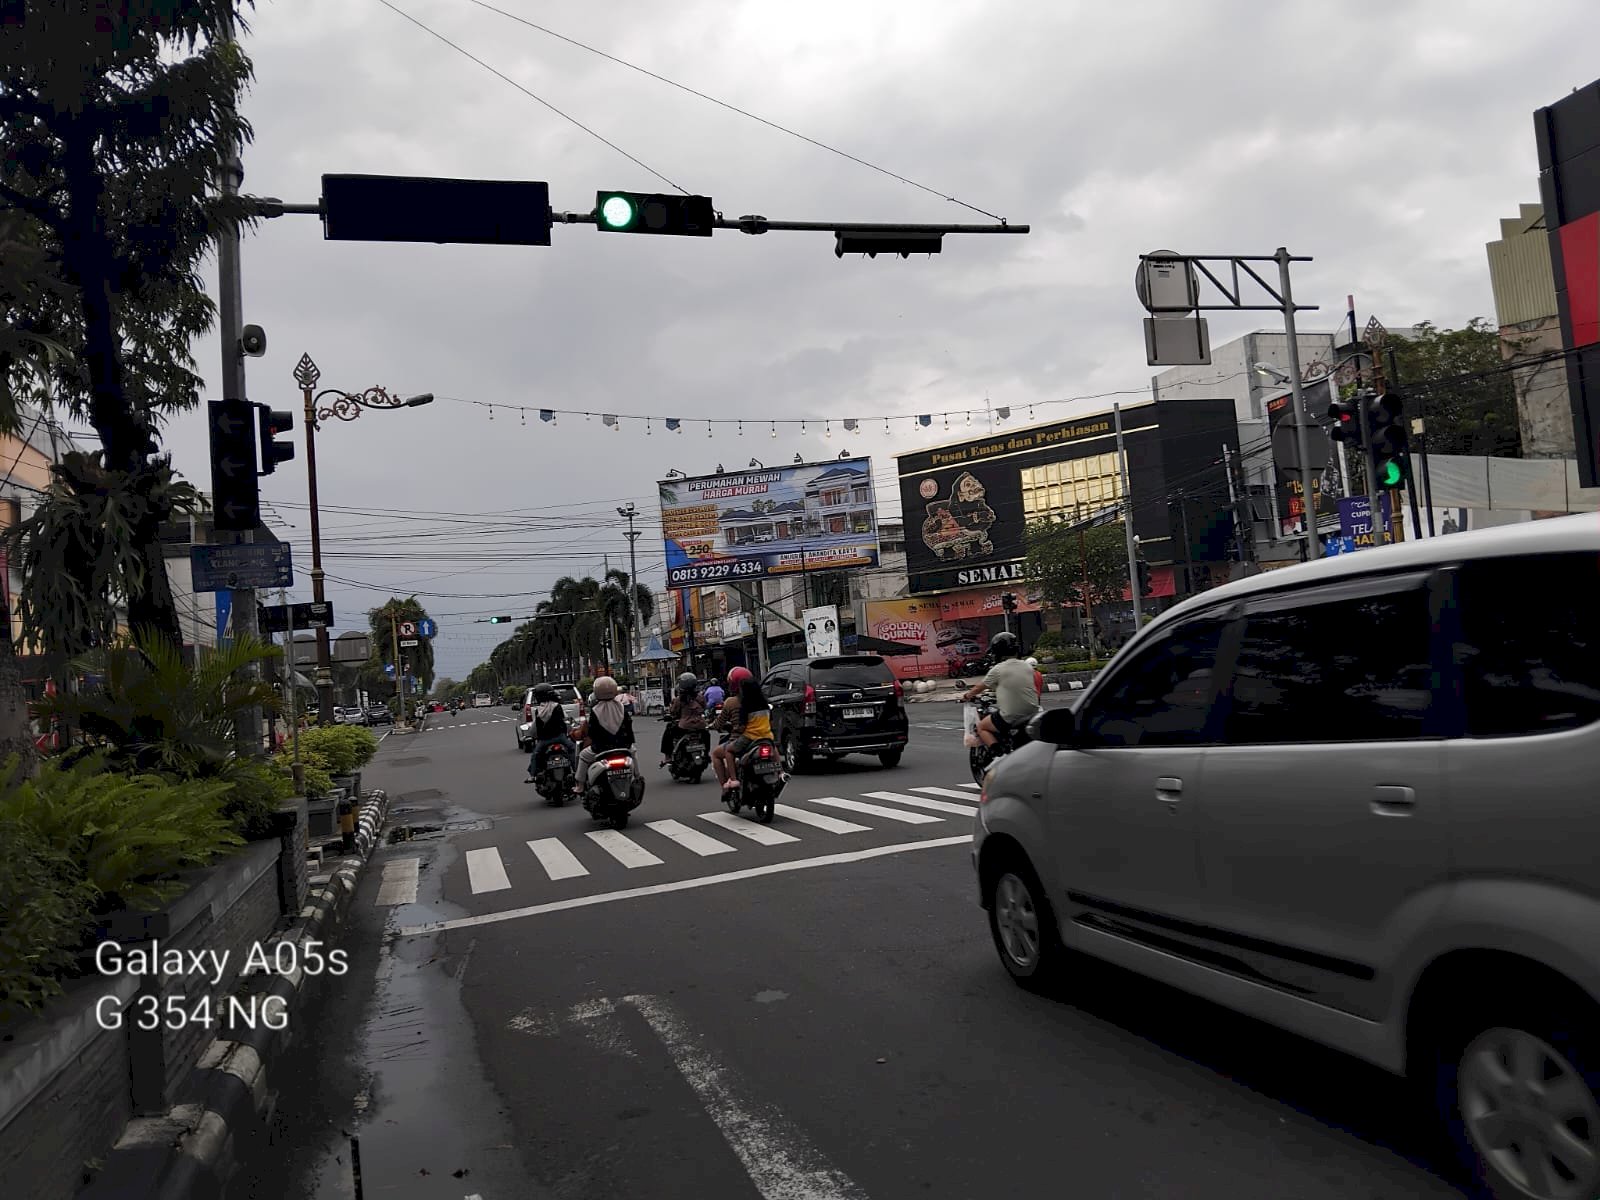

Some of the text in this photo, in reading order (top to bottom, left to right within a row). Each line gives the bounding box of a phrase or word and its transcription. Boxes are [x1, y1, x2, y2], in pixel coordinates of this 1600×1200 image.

[931, 421, 1109, 465] Pusat Emas dan Perhiasan
[689, 473, 781, 491] PERUMAHAN MEWAH
[703, 484, 767, 499] HARGA MURAH
[672, 568, 697, 582] 0813
[700, 565, 729, 578] 9229
[732, 561, 761, 574] 4334
[957, 563, 1024, 585] SEMAR
[880, 621, 922, 633] GOLDEN
